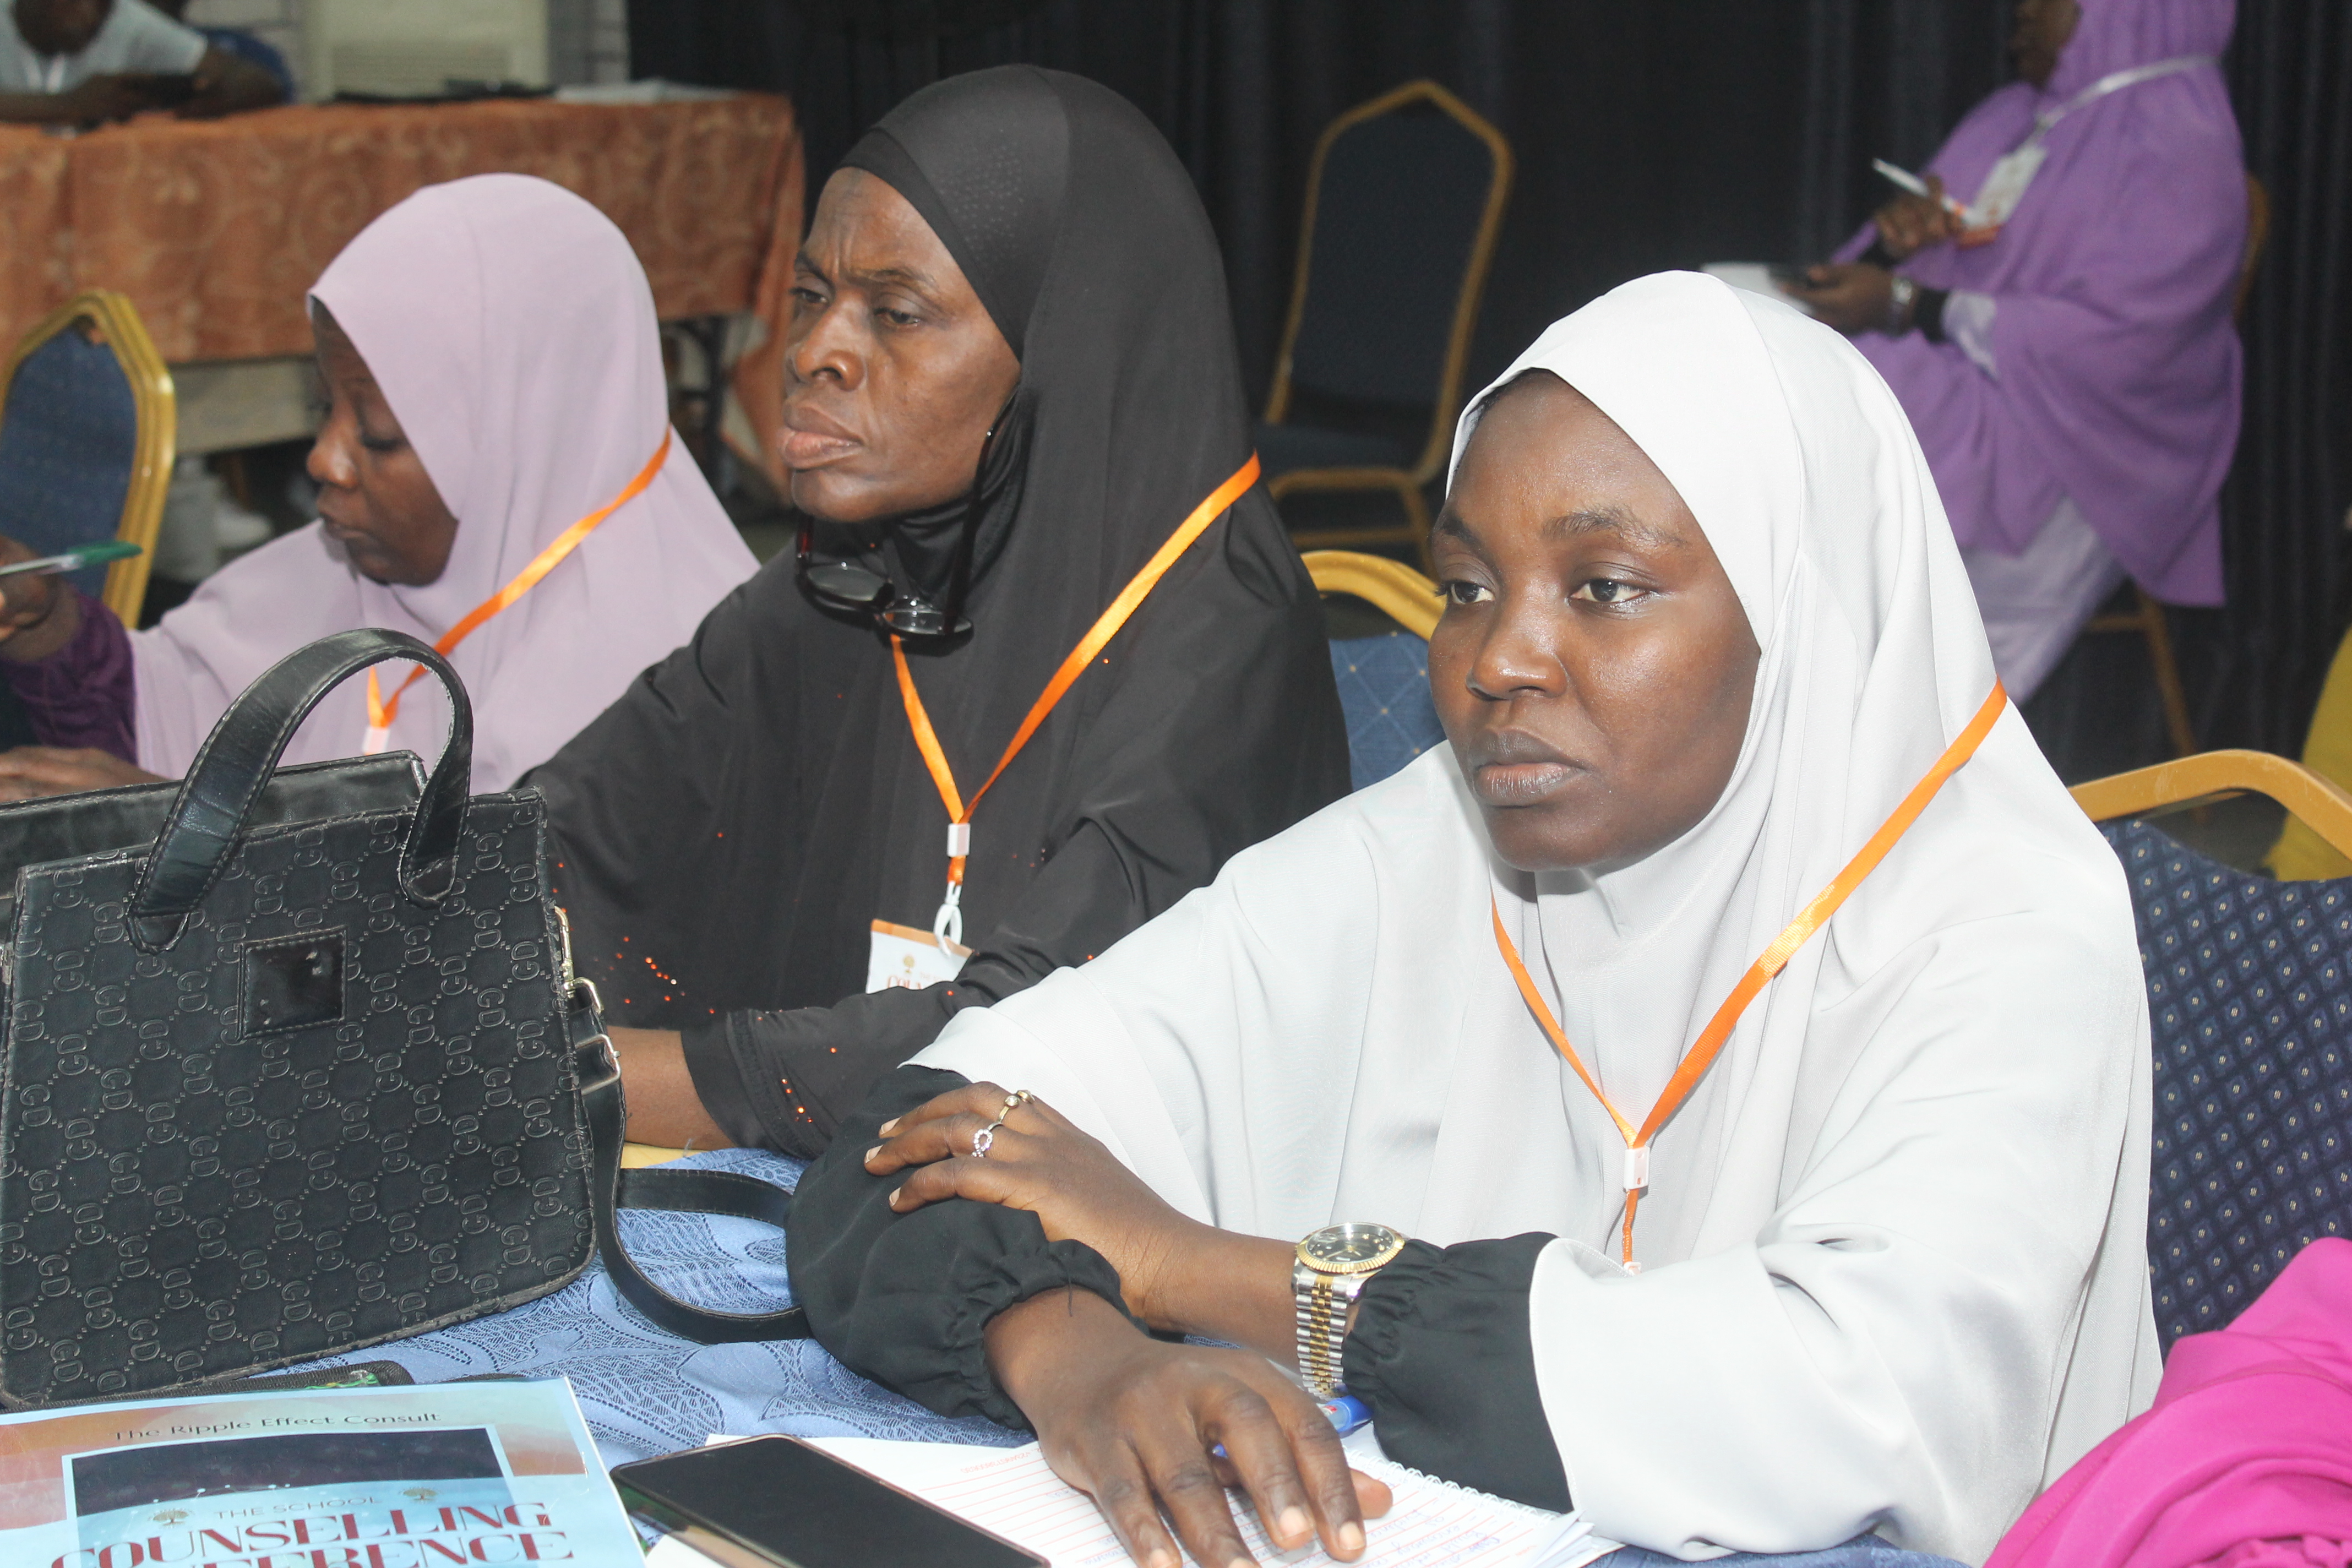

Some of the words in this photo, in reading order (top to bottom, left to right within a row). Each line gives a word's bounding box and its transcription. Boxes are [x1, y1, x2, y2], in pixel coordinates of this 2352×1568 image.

[111, 1430, 160, 1441] The
[171, 1421, 251, 1434] Ripple
[261, 1417, 335, 1427] Effect
[343, 1413, 442, 1424] Consult
[217, 1507, 264, 1520] THE
[272, 1496, 383, 1513] SCHOOL
[51, 1502, 552, 1568] COUNSELLING
